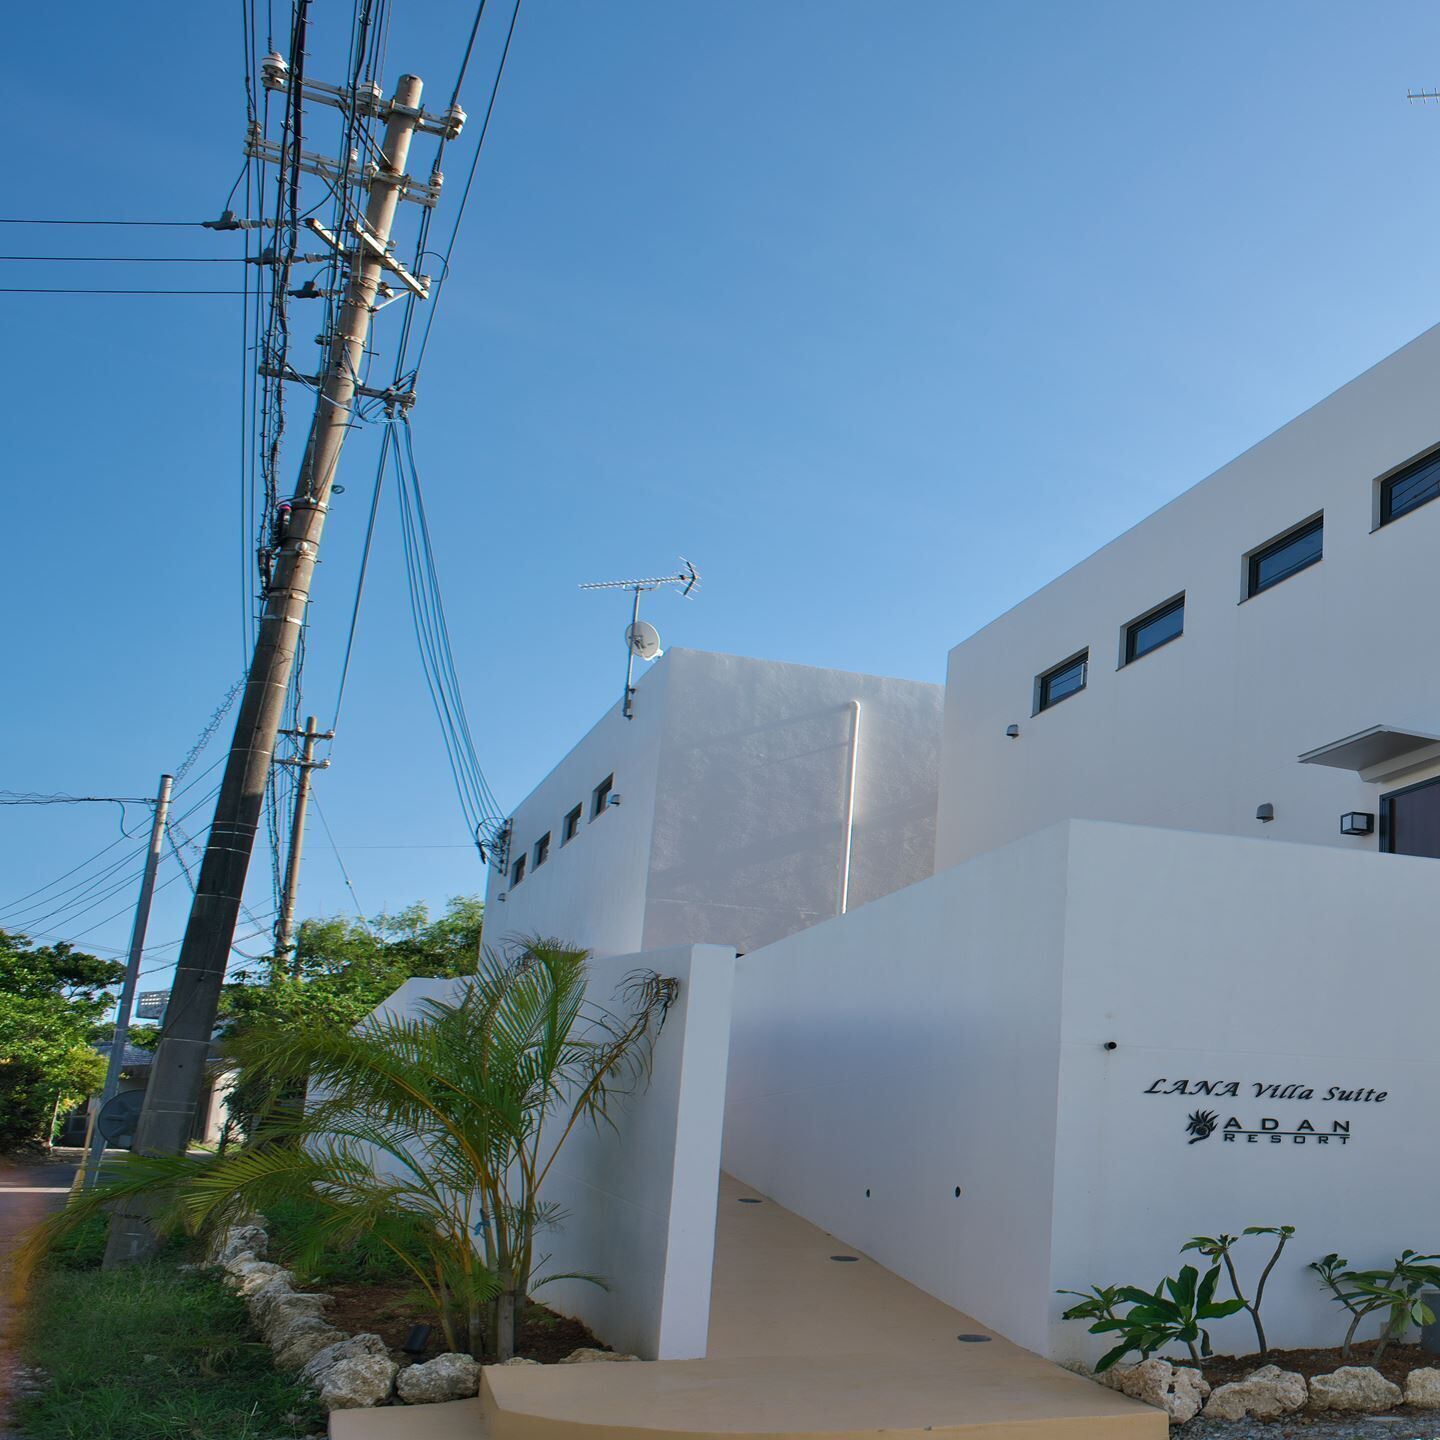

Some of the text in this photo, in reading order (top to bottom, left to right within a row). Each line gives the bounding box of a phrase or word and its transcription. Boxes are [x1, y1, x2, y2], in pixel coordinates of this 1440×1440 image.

[1143, 1078, 1389, 1103] LANA Villa Suite
[1222, 1116, 1351, 1134] ADAN
[1222, 1132, 1351, 1145] RESORT
